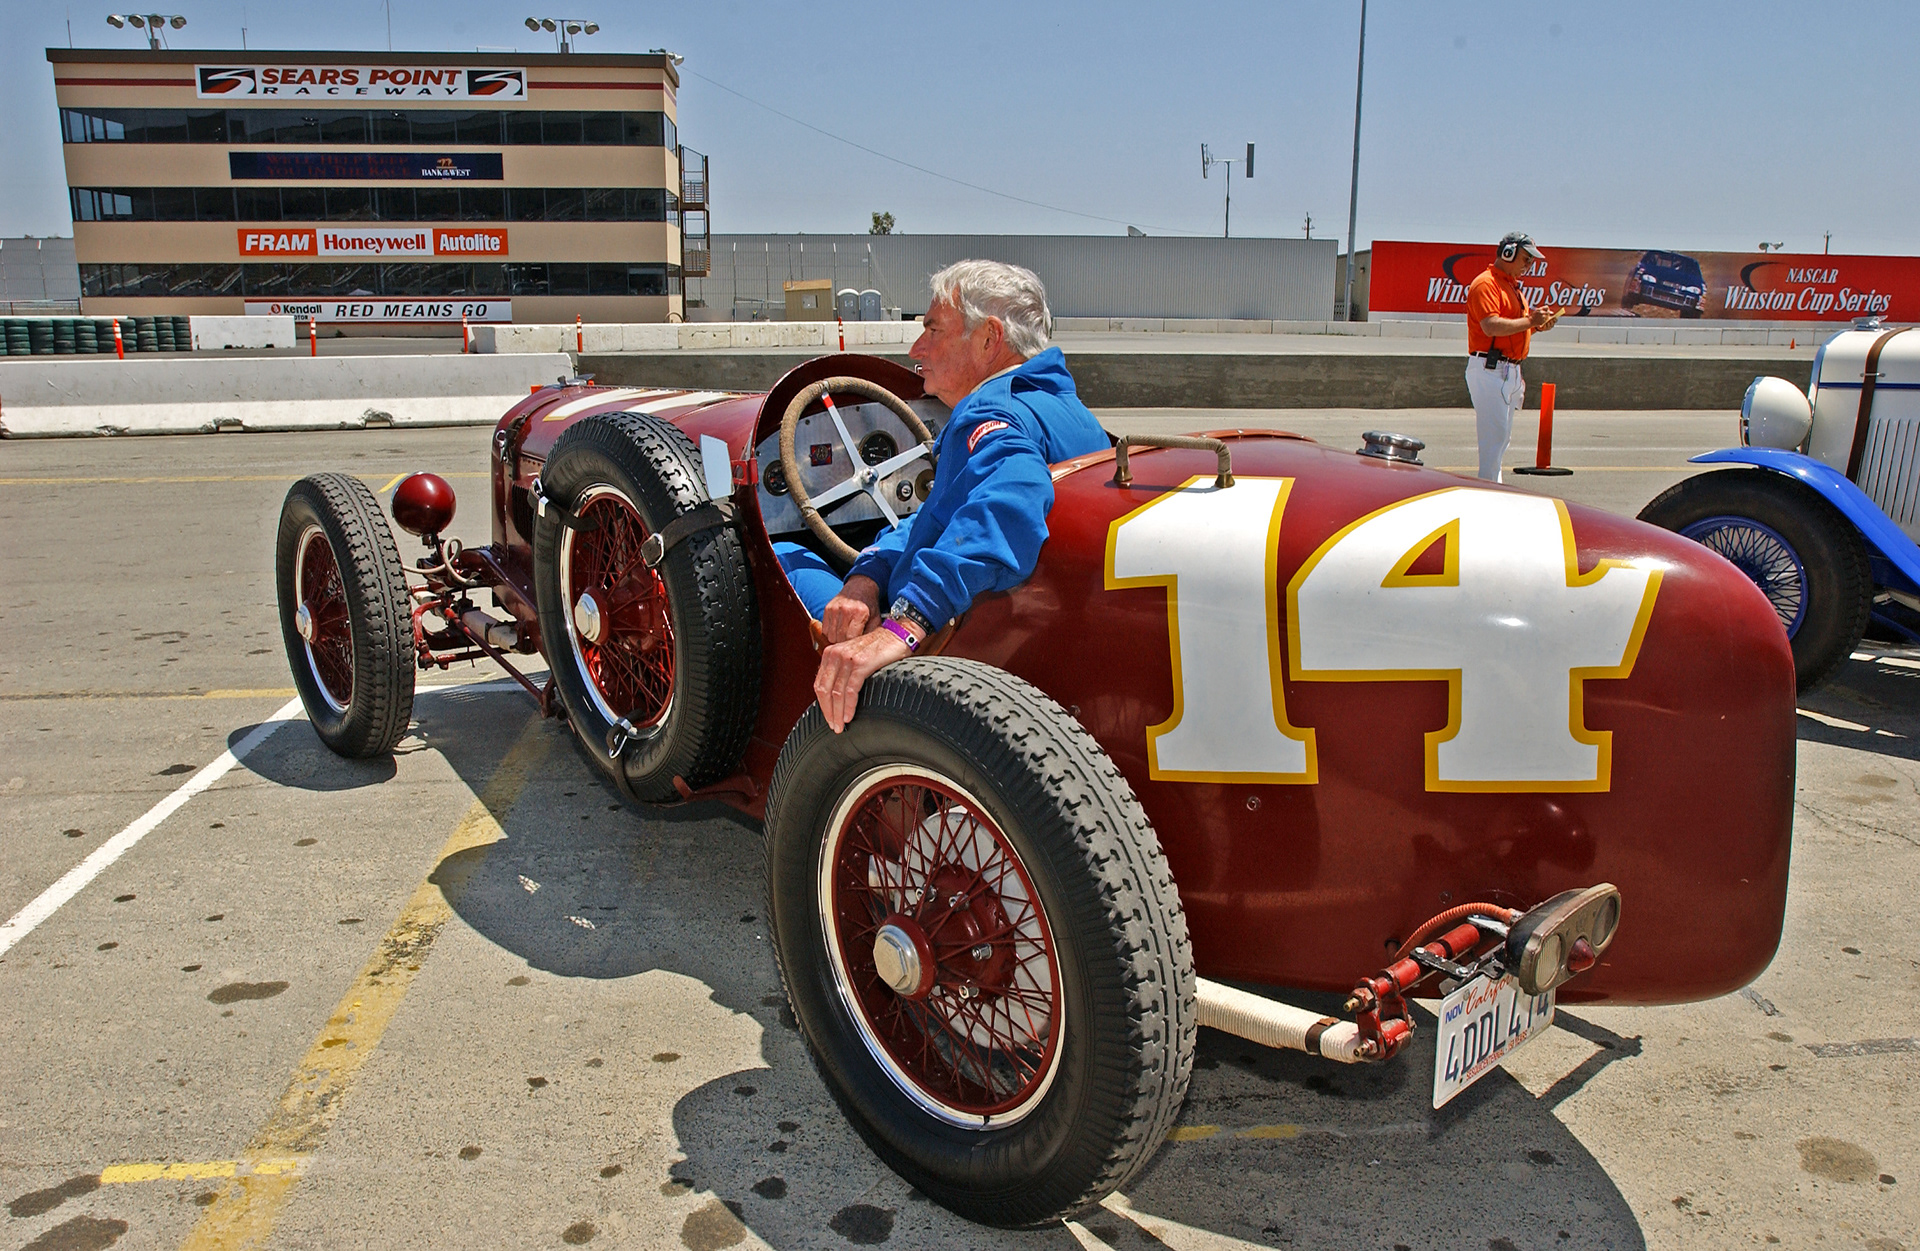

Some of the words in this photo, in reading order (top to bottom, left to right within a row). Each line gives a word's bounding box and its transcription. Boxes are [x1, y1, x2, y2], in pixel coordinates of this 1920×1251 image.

[261, 68, 360, 85] SEARS
[369, 69, 462, 85] POINT
[263, 87, 459, 95] RACEWAY
[421, 168, 443, 177] BANK
[448, 168, 472, 177] WEST
[245, 234, 310, 251] FRAM
[323, 233, 426, 254] Honeywell
[439, 233, 501, 251] Autolite
[1785, 267, 1839, 284] NASCAR
[1426, 277, 1470, 304] Wins
[1544, 280, 1607, 307] Series
[1723, 285, 1798, 312] Winston
[1797, 286, 1835, 314] Cup
[1834, 287, 1892, 313] Series
[283, 304, 322, 314] Kendall
[335, 304, 374, 317] RED
[383, 304, 453, 317] MEANS
[462, 303, 488, 317] GO
[971, 420, 1002, 445] SIMPSON
[1104, 475, 1664, 792] 14
[1445, 1001, 1464, 1024] NOV
